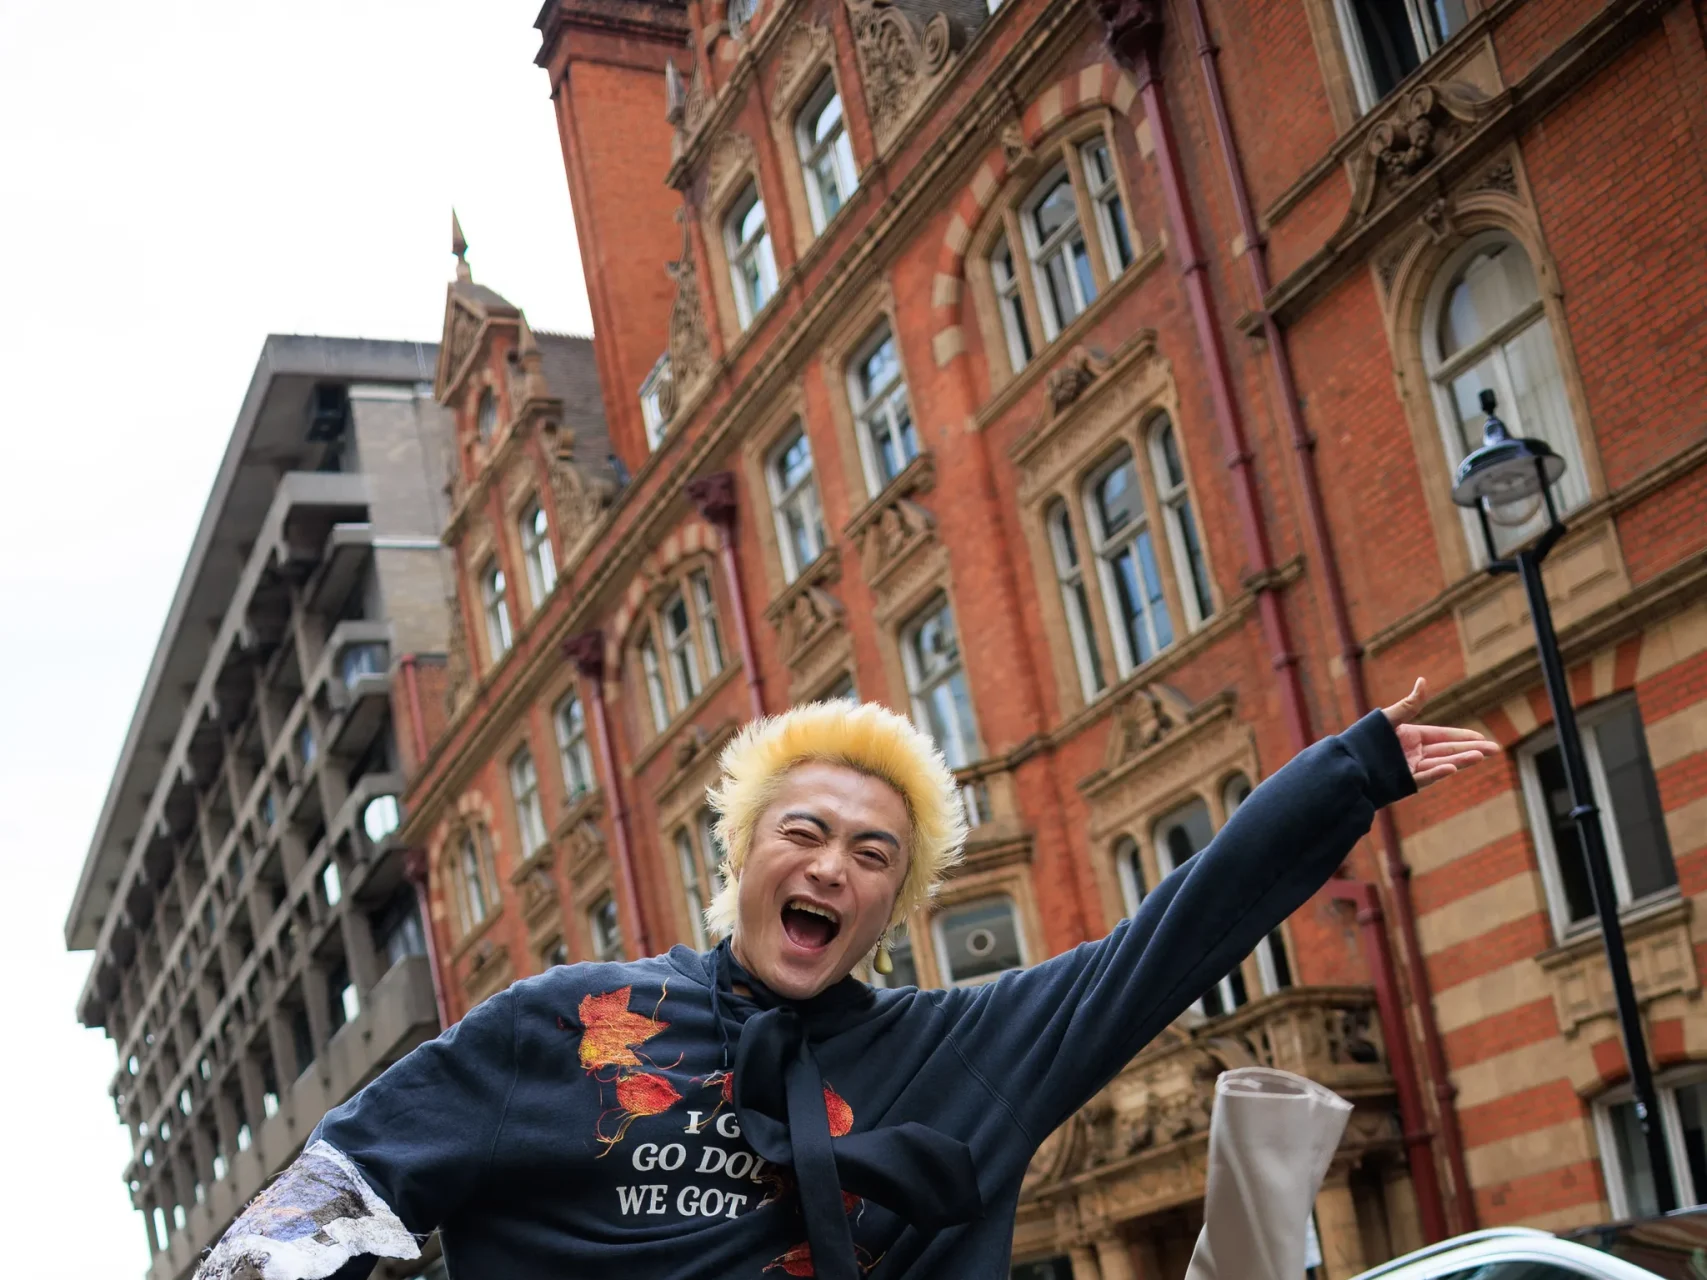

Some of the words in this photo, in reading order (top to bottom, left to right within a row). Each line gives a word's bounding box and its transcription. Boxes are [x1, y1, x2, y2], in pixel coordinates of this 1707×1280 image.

[684, 1111, 703, 1134] I
[632, 1143, 687, 1171] GO
[616, 1184, 669, 1215] WE
[676, 1185, 748, 1219] GOT
